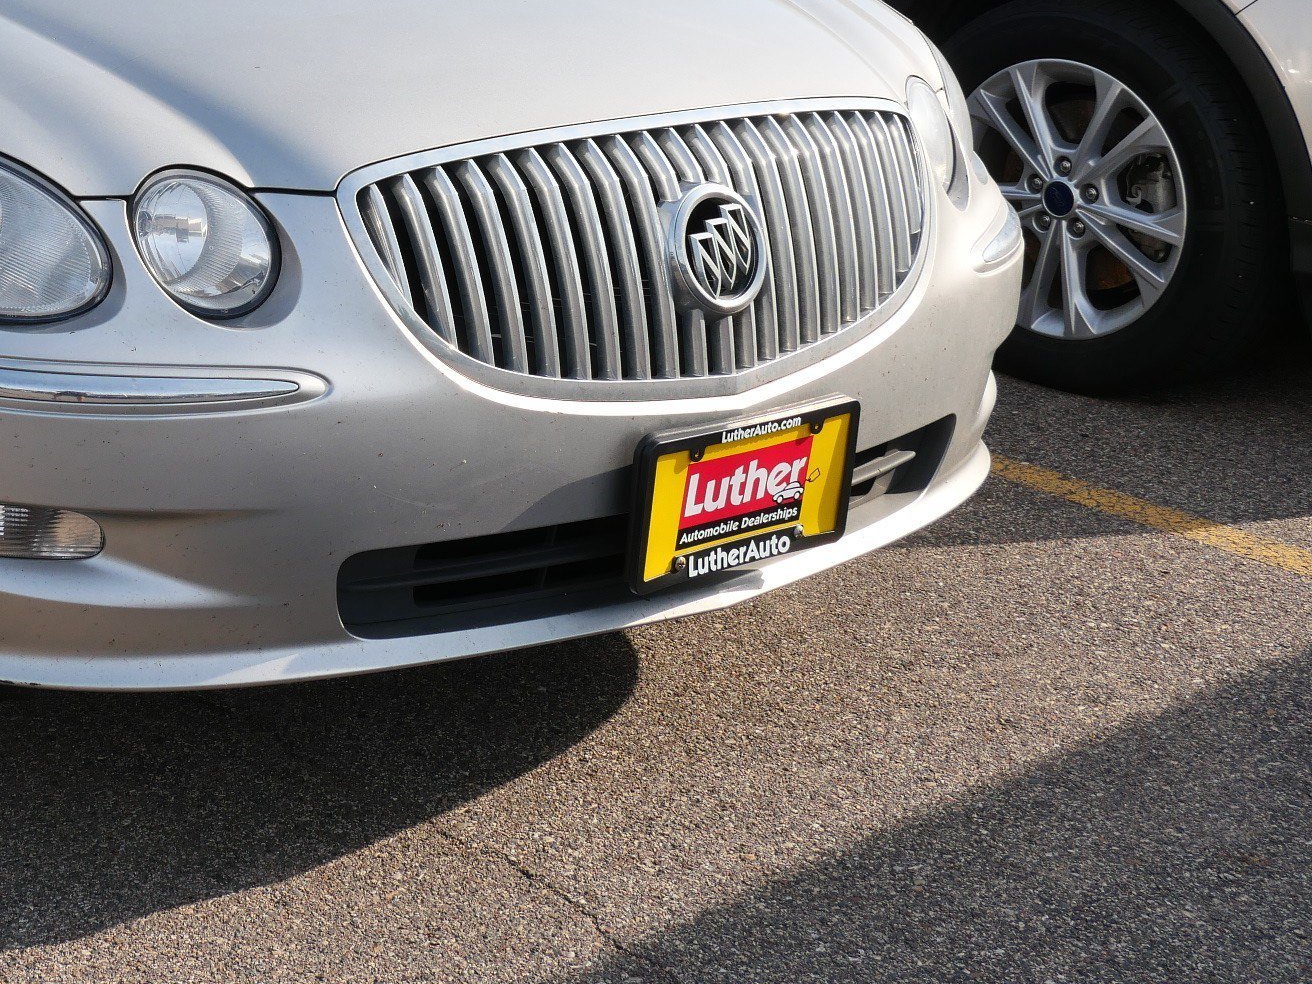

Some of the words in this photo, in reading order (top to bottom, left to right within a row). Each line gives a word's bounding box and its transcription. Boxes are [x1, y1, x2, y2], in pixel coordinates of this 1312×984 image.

[721, 416, 802, 444] LutherAuto.com
[684, 456, 808, 518] Luther
[679, 520, 740, 545] Automobile
[740, 506, 798, 529] Dealerships
[688, 534, 791, 578] LutherAuto
